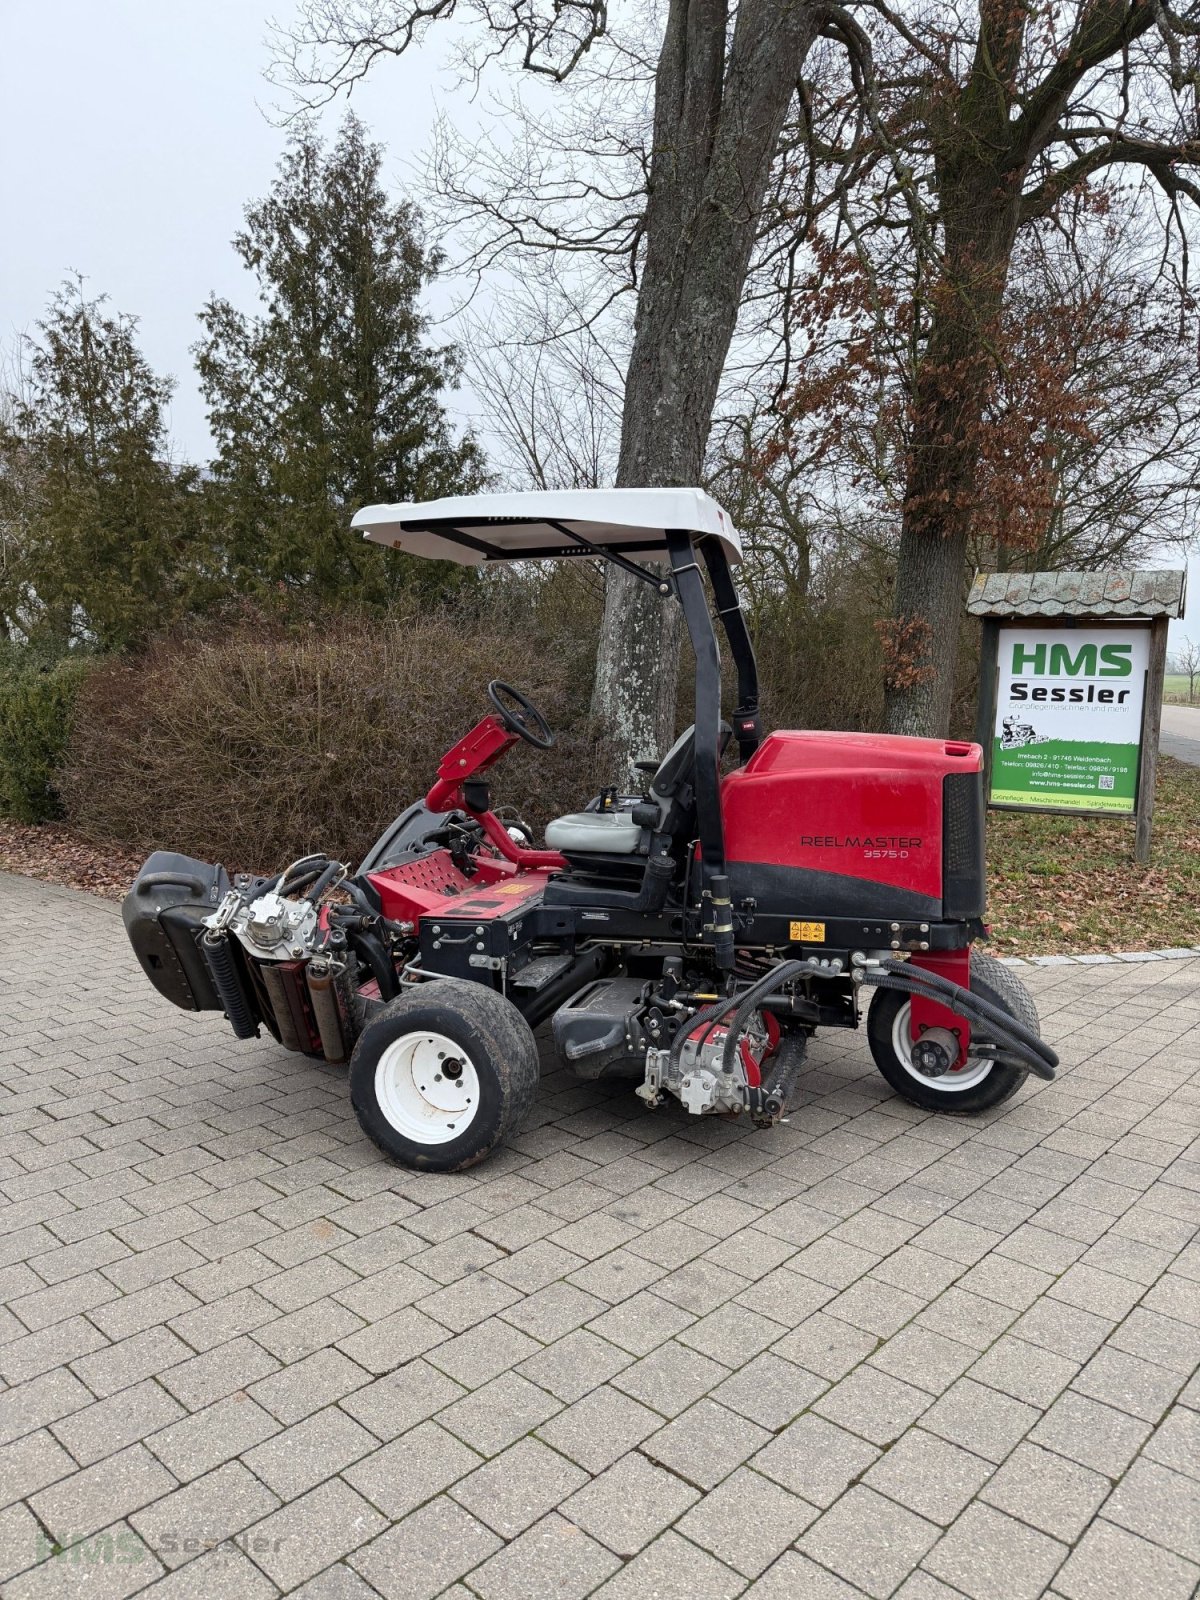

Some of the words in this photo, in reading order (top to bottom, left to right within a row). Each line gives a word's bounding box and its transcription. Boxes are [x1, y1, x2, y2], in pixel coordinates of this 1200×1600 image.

[1011, 643, 1133, 677] HMS
[1009, 682, 1131, 704] Sessler
[1091, 705, 1106, 713] und
[1073, 755, 1112, 764] Weidenbach
[1029, 778, 1096, 790] www.hms-sessler.de
[800, 836, 923, 849] REELMASTER
